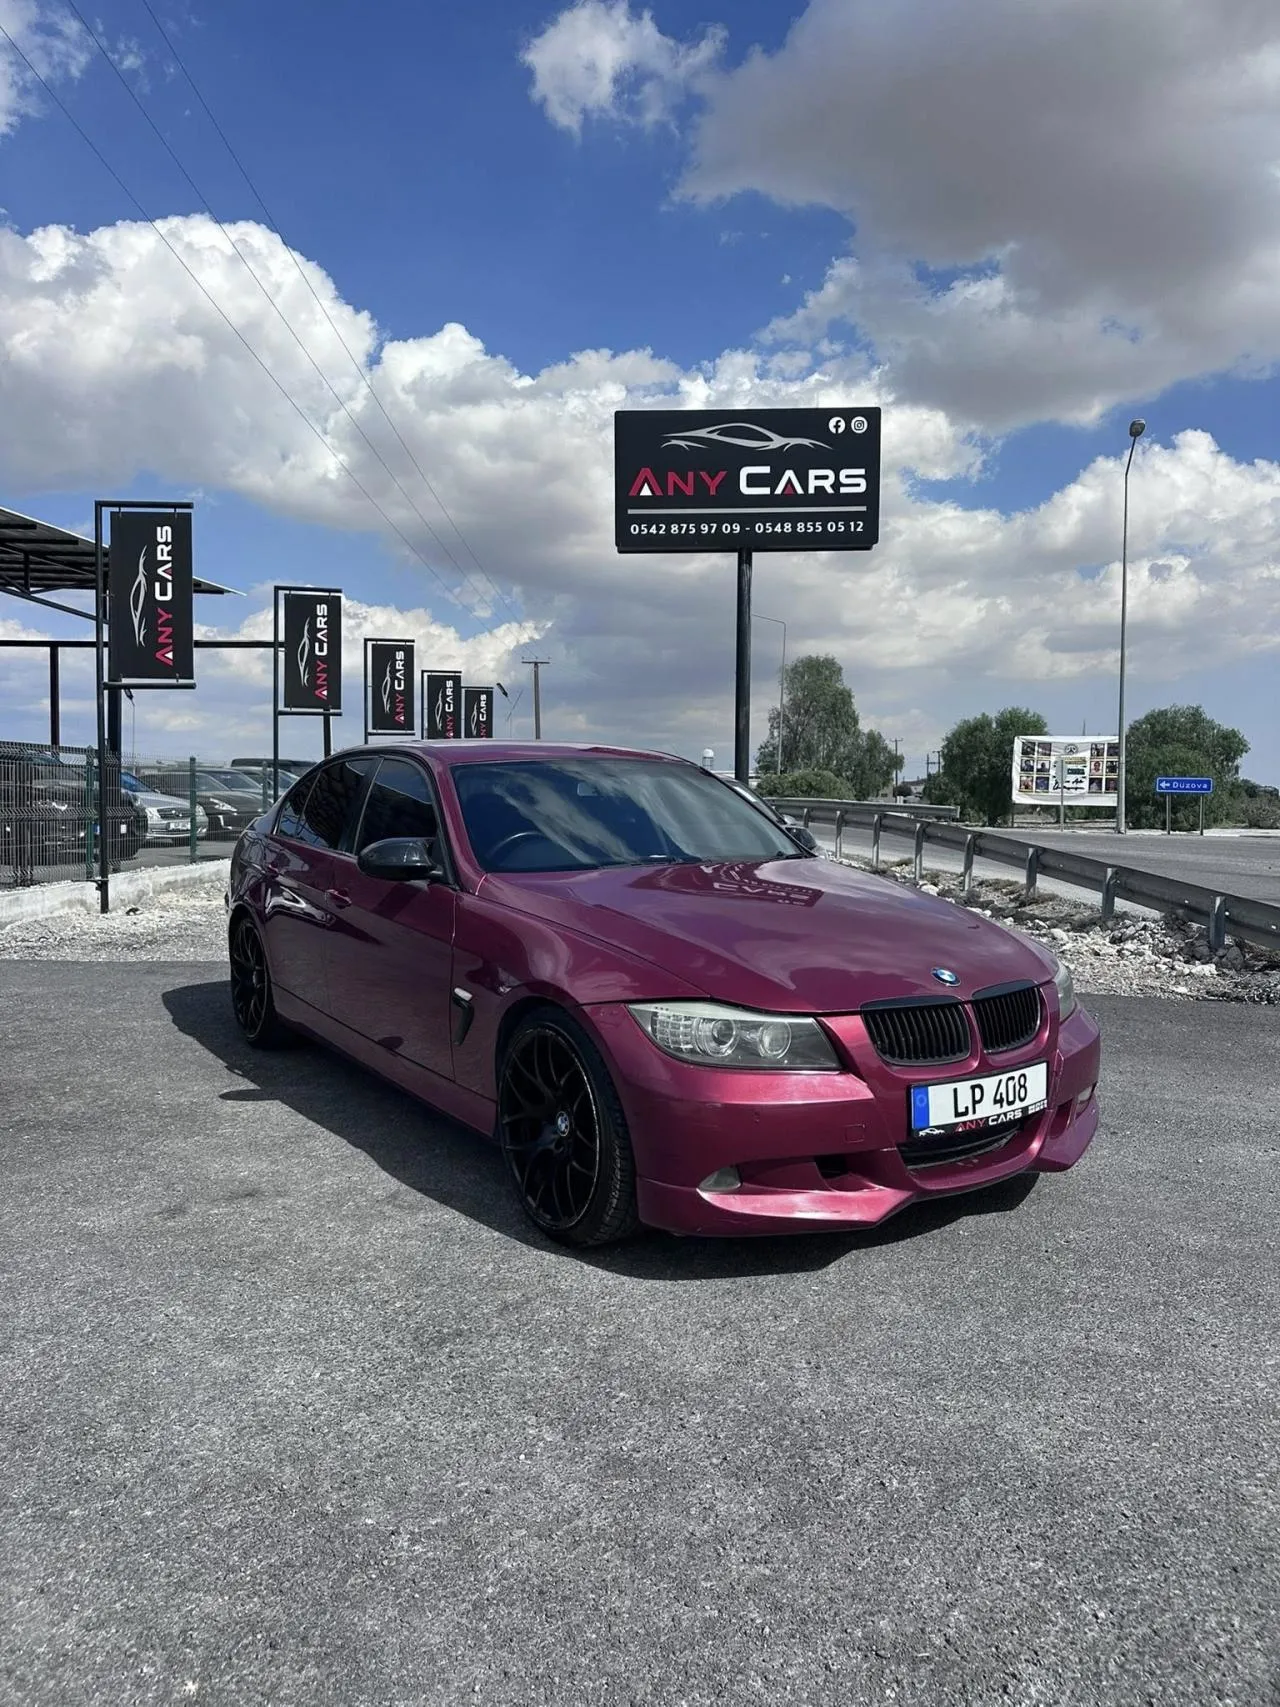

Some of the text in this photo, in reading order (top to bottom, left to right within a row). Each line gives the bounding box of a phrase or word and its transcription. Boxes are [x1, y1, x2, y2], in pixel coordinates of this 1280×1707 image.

[628, 465, 867, 496] ANY CARS
[630, 523, 666, 535] 0542
[670, 523, 696, 534] 875
[700, 523, 717, 534] 97
[722, 522, 740, 534] 09
[755, 522, 792, 533] 0548
[796, 521, 822, 533] 855
[827, 521, 845, 532] 05
[849, 521, 864, 532] 12
[154, 525, 174, 666] ANY CARS
[314, 603, 328, 700] ANY CARS
[394, 650, 405, 724] ANY CARS
[445, 680, 454, 712] CARS
[479, 694, 487, 721] CARS
[1172, 781, 1208, 789] Düzova
[953, 1083, 984, 1118] LP
[993, 1073, 1028, 1109] 408
[954, 1108, 1022, 1132] ANY CARS
